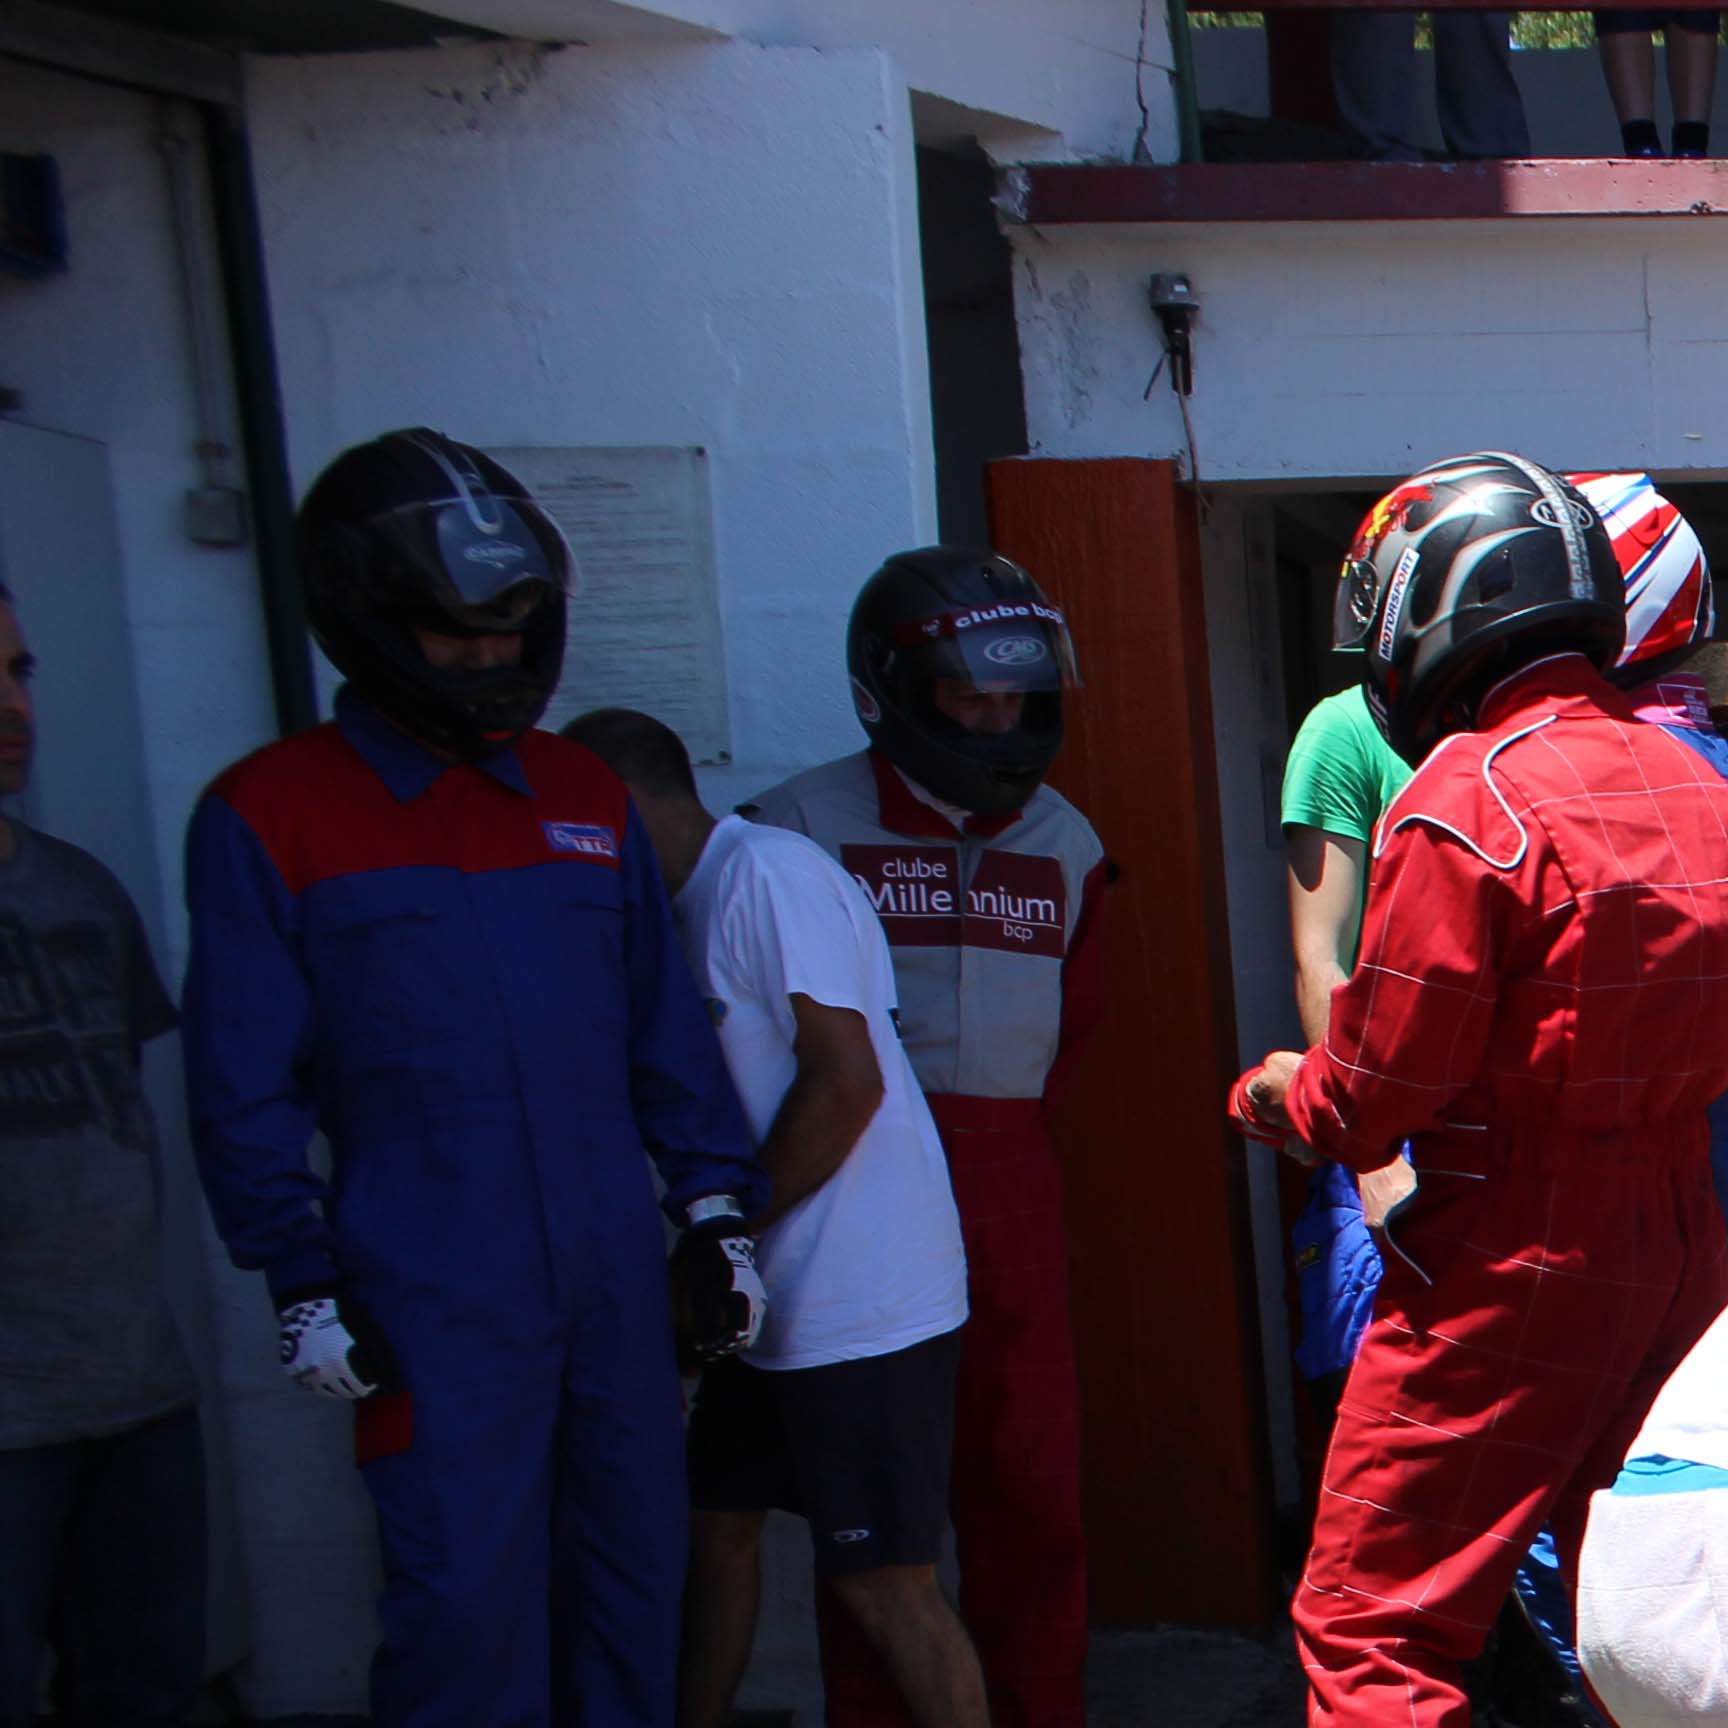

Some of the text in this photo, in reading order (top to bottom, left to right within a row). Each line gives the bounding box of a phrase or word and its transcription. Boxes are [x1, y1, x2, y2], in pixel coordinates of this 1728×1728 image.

[953, 603, 1031, 630] clube
[1379, 553, 1417, 662] MOTORSPORT
[881, 856, 948, 880] clube
[1003, 919, 1035, 943] bcp
